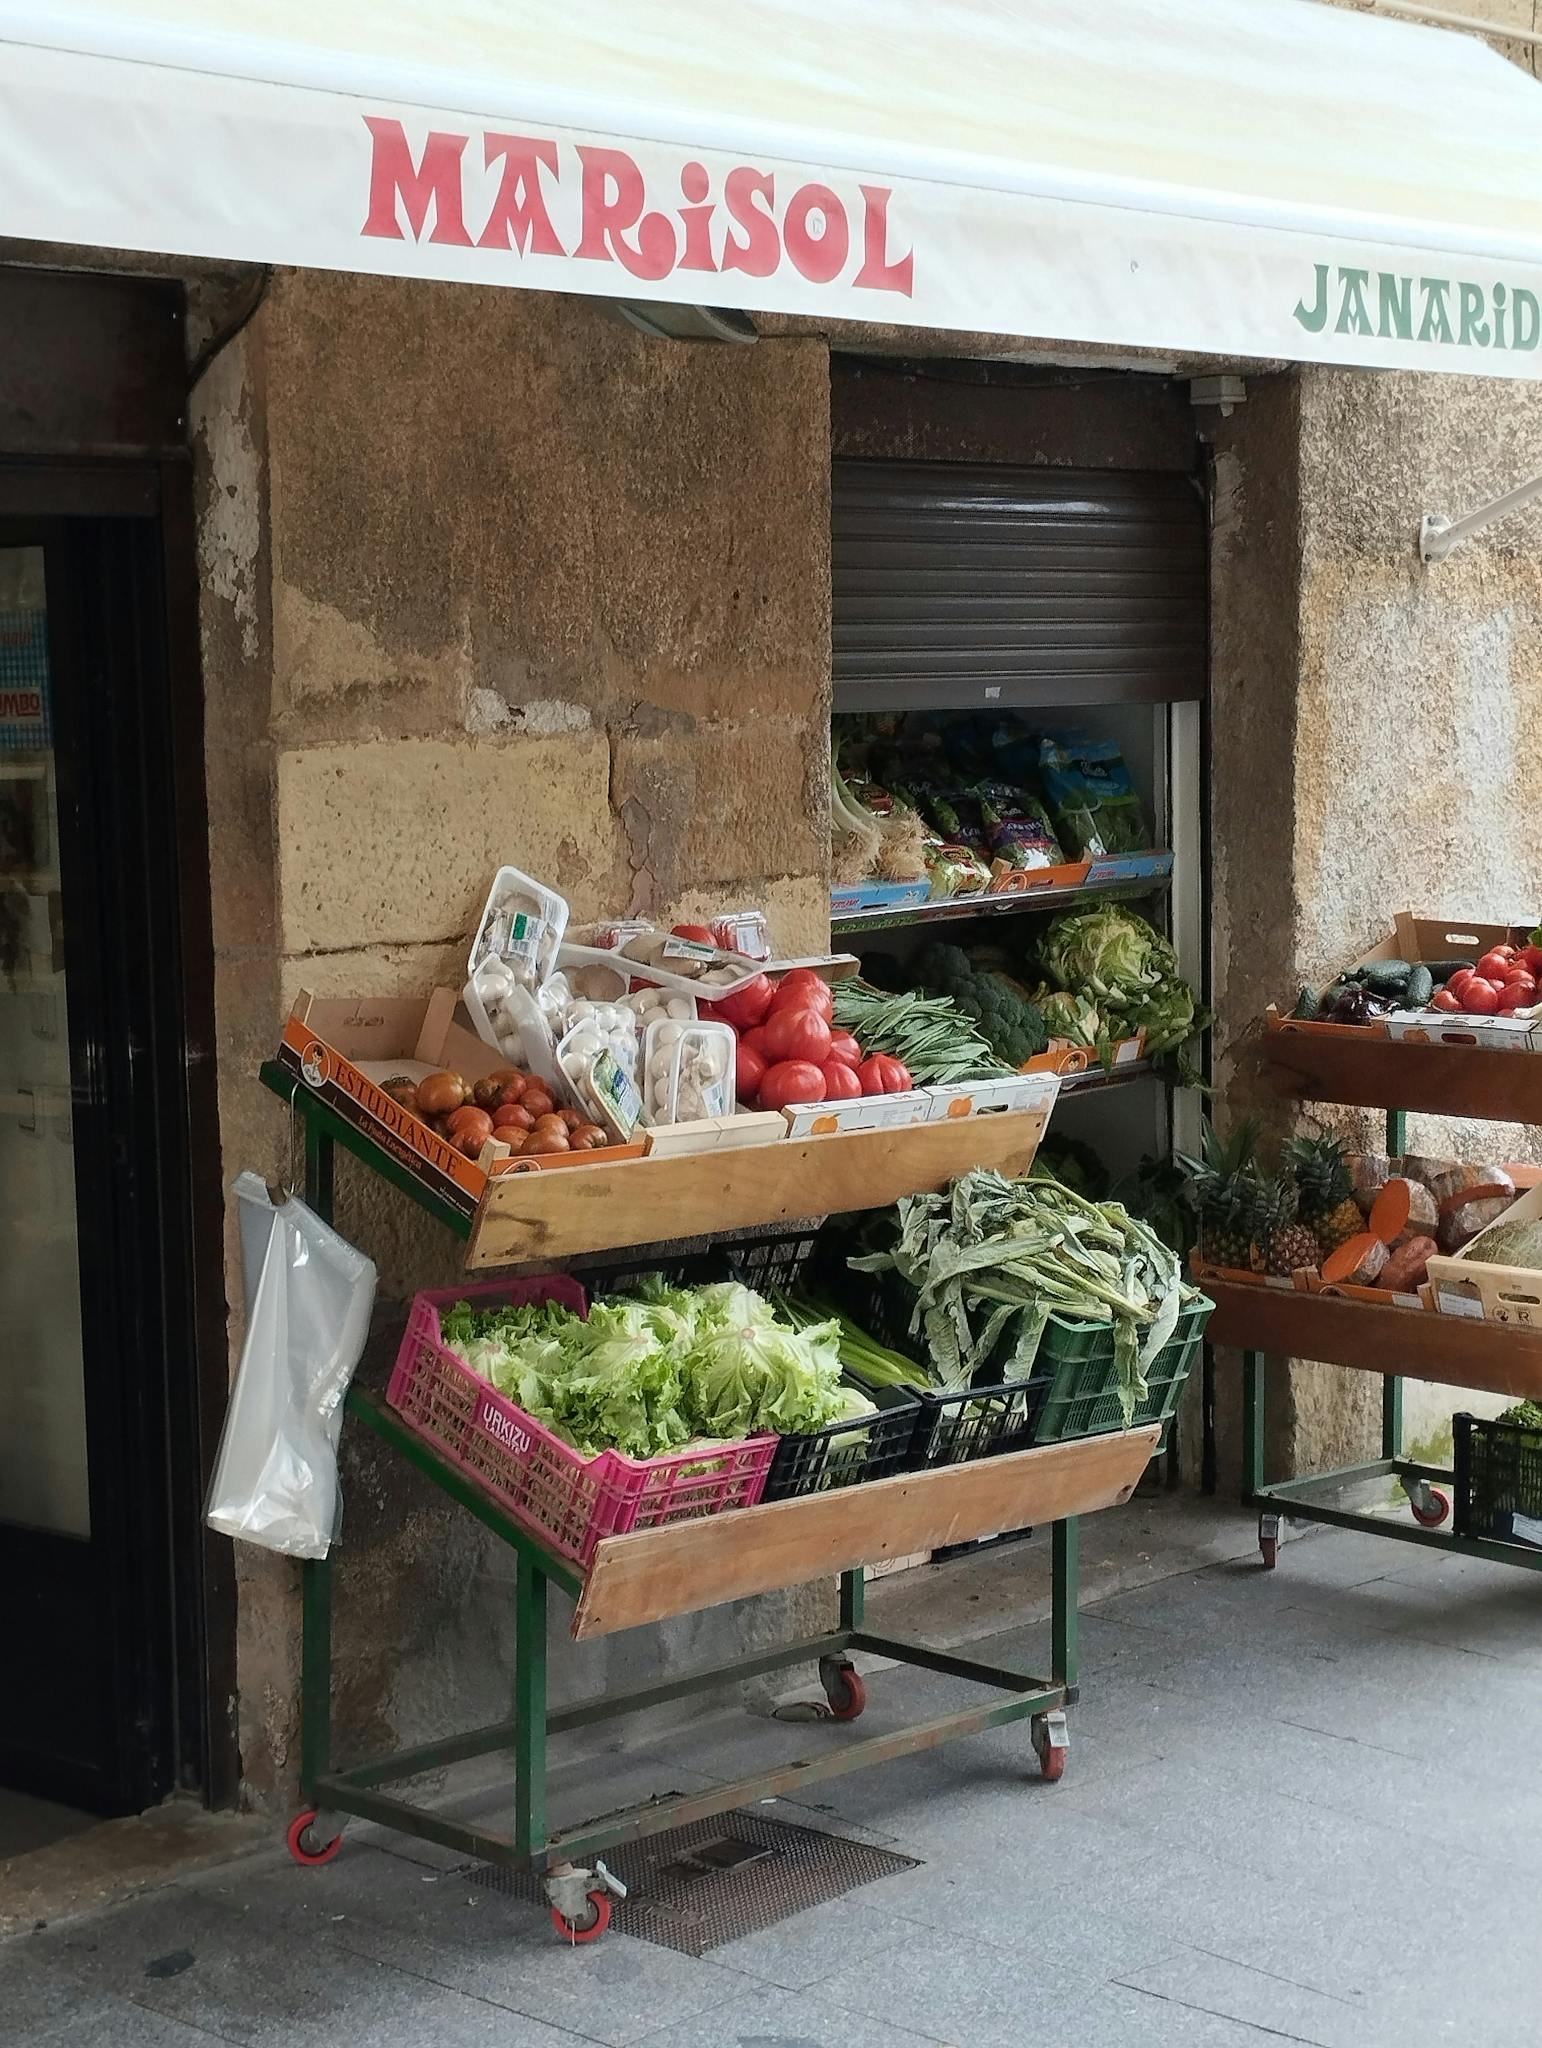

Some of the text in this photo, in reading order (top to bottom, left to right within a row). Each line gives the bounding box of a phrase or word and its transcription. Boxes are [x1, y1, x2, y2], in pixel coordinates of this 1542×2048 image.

[0, 693, 41, 717] MBO
[334, 1061, 458, 1177] ESTUDIANTE
[483, 1402, 531, 1453] URKIZU
